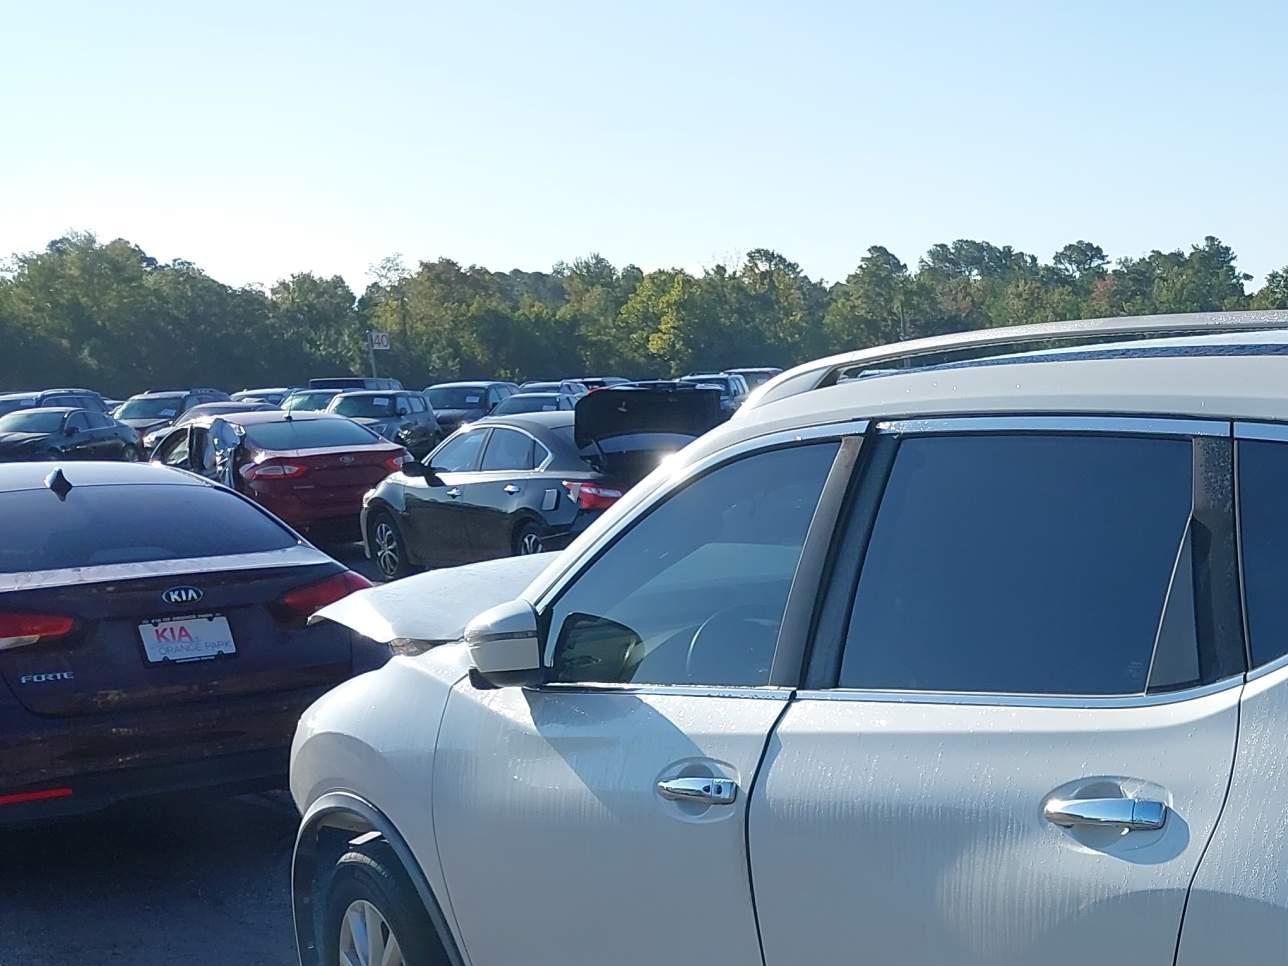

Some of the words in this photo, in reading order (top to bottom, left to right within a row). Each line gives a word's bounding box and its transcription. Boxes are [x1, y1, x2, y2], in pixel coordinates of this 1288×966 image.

[169, 589, 198, 603] KIA
[154, 626, 192, 643] KIA
[21, 671, 74, 684] FORTE
